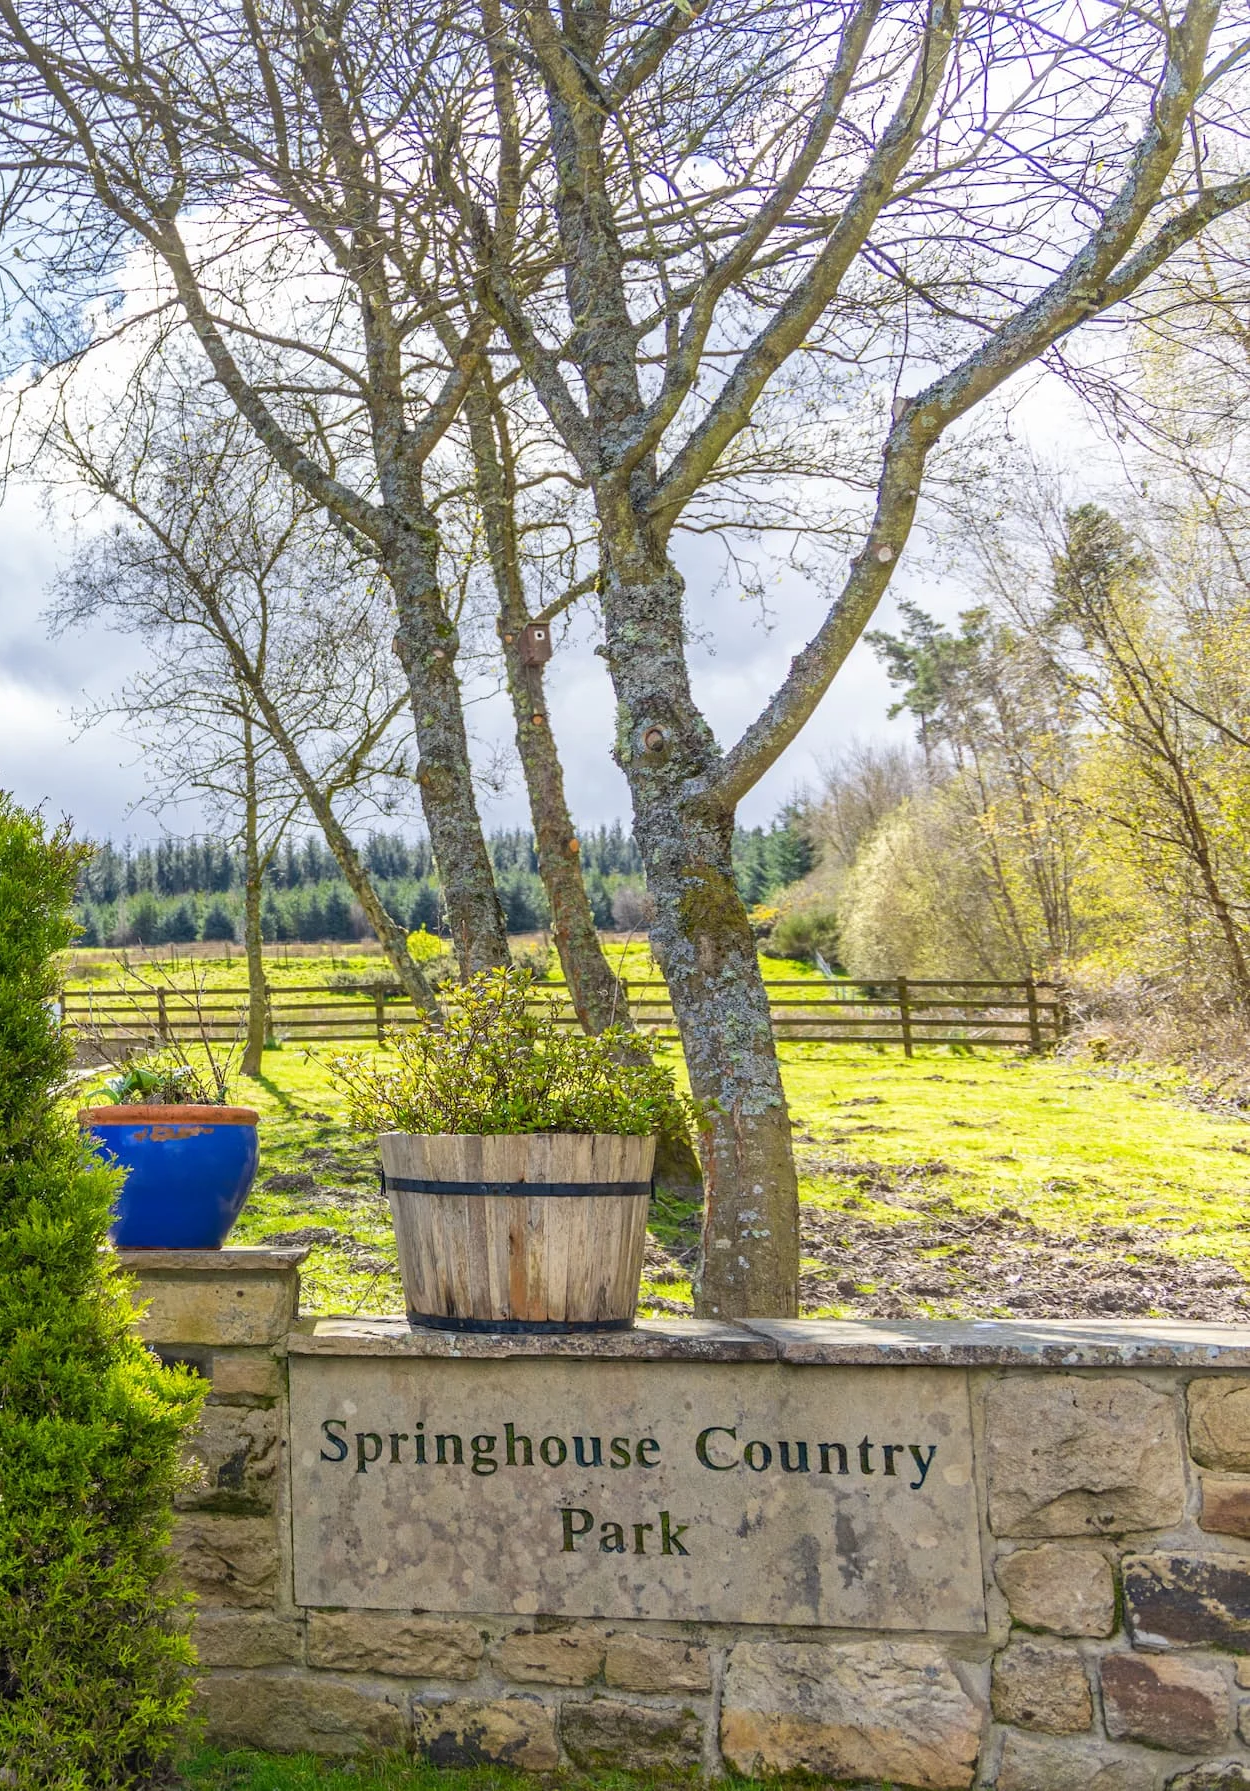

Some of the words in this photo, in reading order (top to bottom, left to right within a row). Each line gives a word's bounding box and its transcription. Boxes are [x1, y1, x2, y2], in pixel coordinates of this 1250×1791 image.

[319, 1420, 662, 1476] Springhouse
[695, 1426, 938, 1490] Country
[559, 1507, 690, 1556] Park
